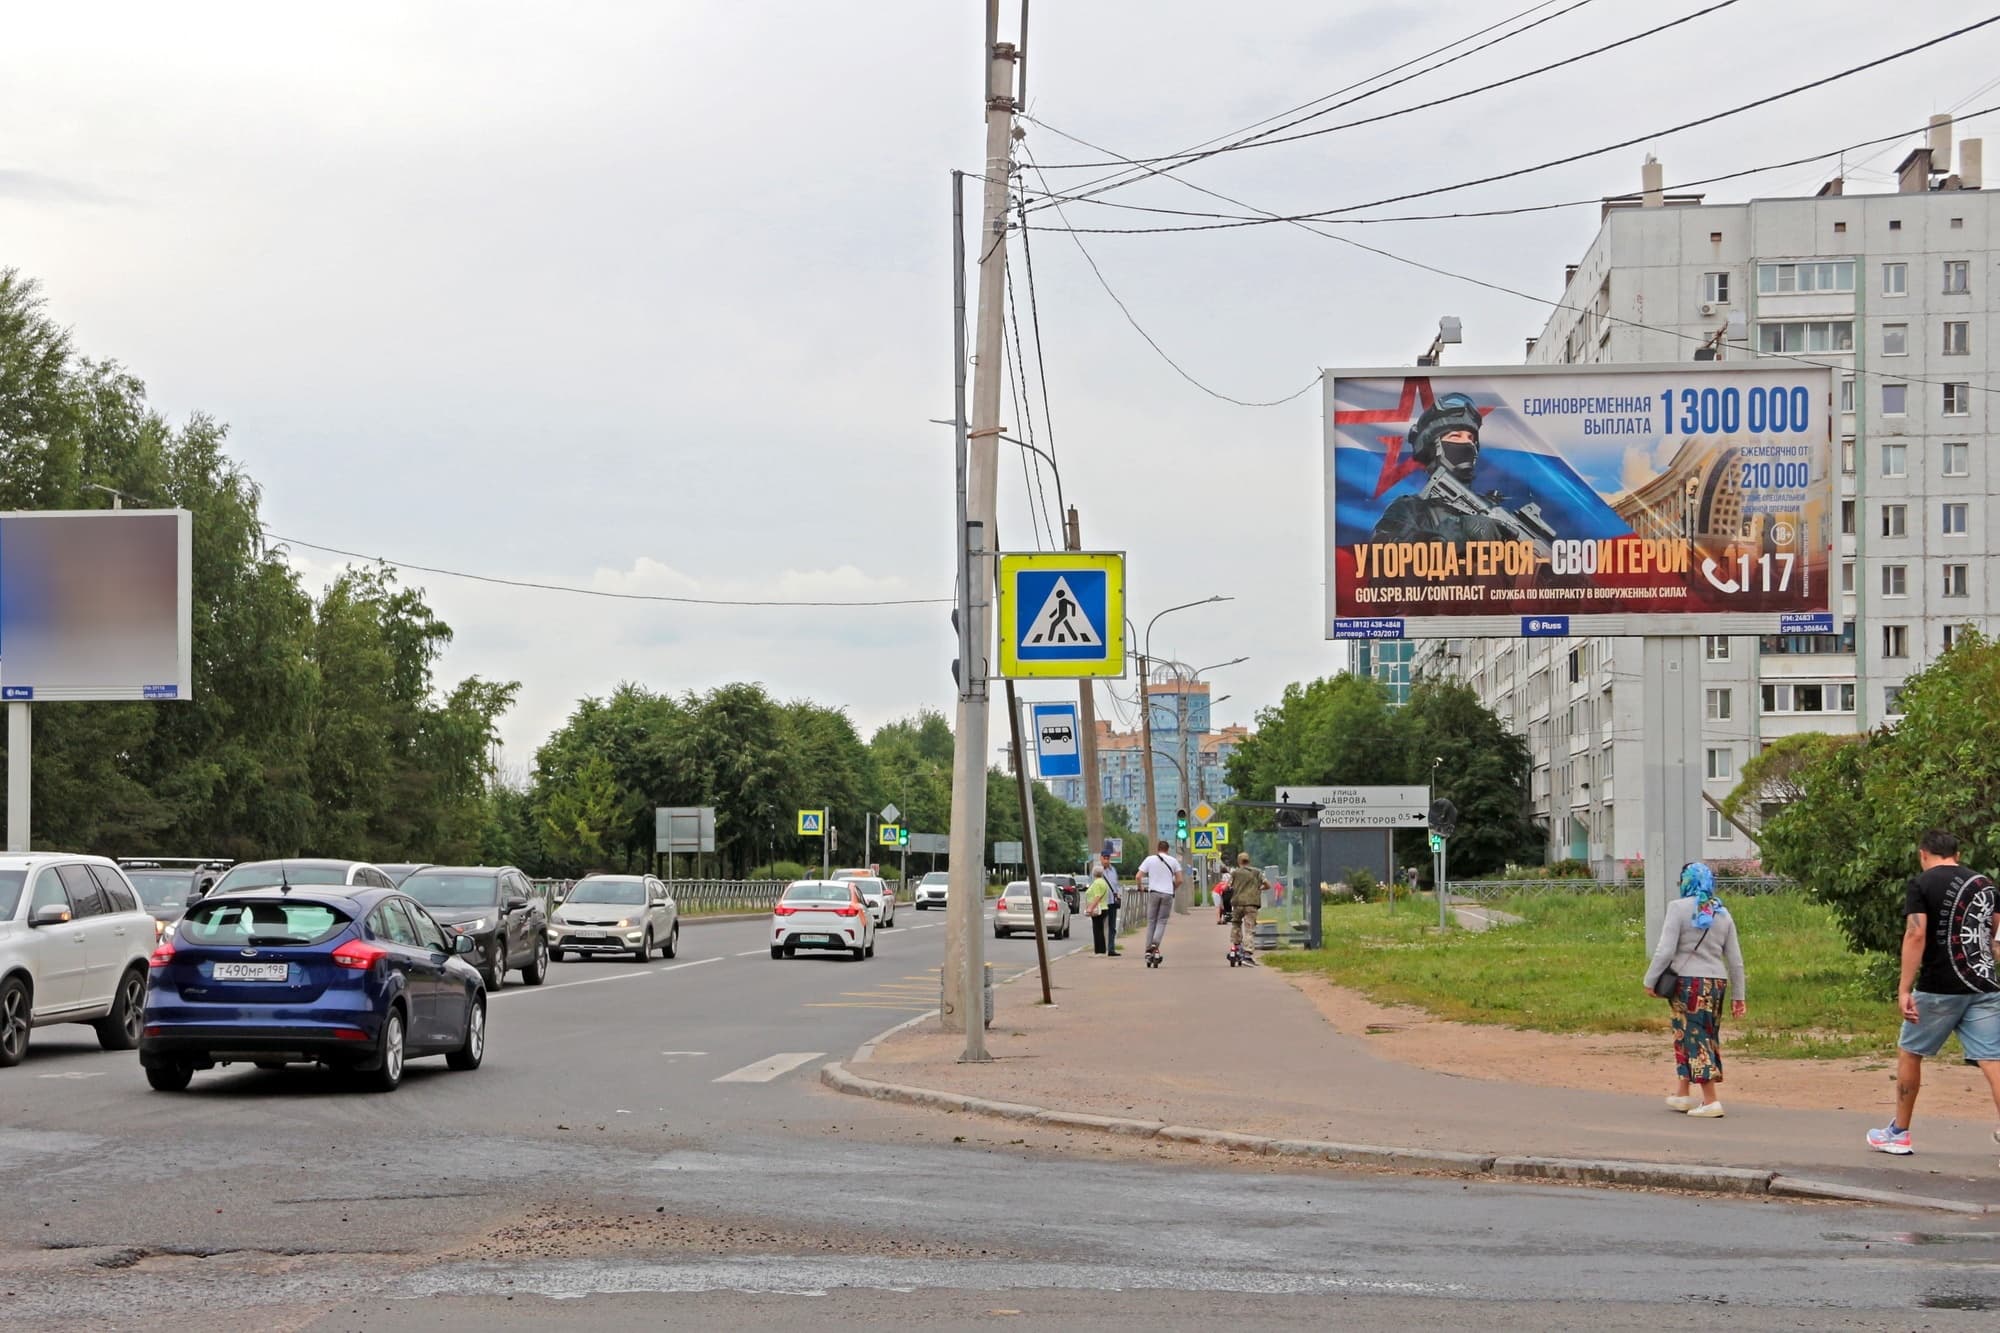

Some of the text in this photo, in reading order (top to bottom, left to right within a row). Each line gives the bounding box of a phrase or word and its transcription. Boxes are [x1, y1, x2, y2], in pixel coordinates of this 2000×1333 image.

[1523, 396, 1652, 416] ЕДИНОВРЕМЕННАЯ
[1660, 386, 1809, 435] 1 300 000
[1584, 417, 1652, 435] ВЫПЛАТА
[1741, 446, 1809, 457] ЕЖЕМЕСЯЧНО ОТ
[1741, 462, 1808, 488] 210 000
[1354, 544, 1368, 578] У
[1552, 539, 1612, 575] СВОИ
[1617, 538, 1688, 574] ГЕРОИ
[1737, 552, 1794, 592] 117
[1355, 585, 1486, 603] GOV.SPB.RU/CONTRACT
[1490, 586, 1687, 601] СЛУЖБА ПО КОНТРАКТУ В ВООРУЖЕННЫХ СИЛАХ
[1541, 622, 1562, 630] Russ
[1320, 816, 1396, 825] КОНСТРУКТОРОВ
[1325, 809, 1365, 818] проспект
